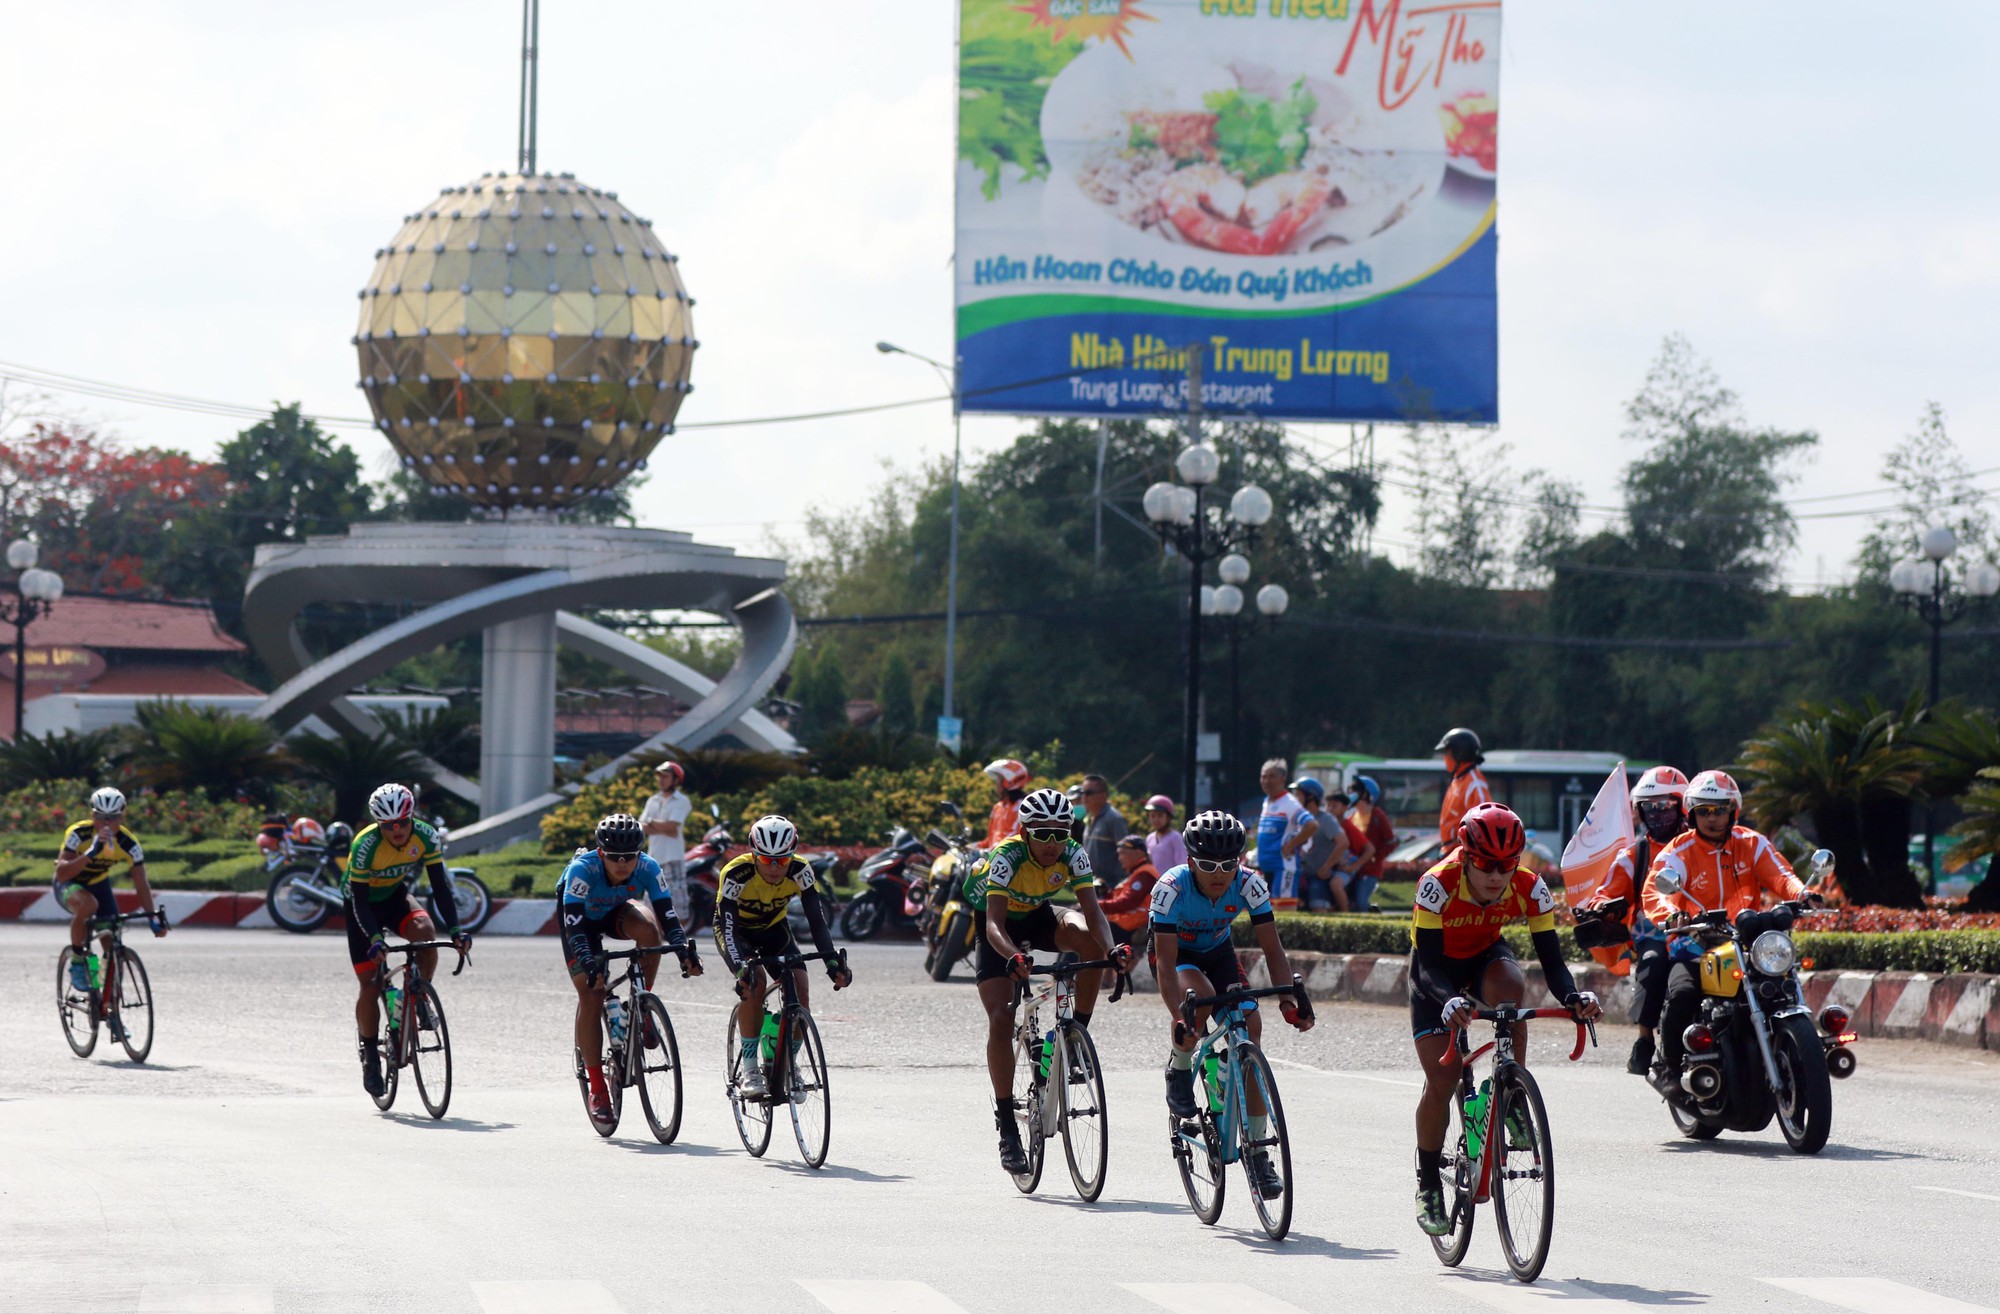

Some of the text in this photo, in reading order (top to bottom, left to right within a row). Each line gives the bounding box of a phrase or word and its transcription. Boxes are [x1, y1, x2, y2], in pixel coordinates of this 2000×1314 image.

[974, 254, 1372, 302] Hân Hoan Chào Đón Quý Khách
[1071, 331, 1390, 383] Nhà Hàn Trung Lương
[1069, 377, 1119, 407] Trung
[1178, 379, 1274, 408] Rstaurant
[356, 834, 377, 870] CALYTOS
[1077, 853, 1090, 871] 52
[797, 870, 814, 887] 73
[992, 860, 1009, 880] 52
[572, 883, 588, 897] 42
[725, 881, 741, 898] 73
[1152, 889, 1169, 908] 41
[1251, 879, 1268, 900] 41
[1420, 881, 1440, 904] 95
